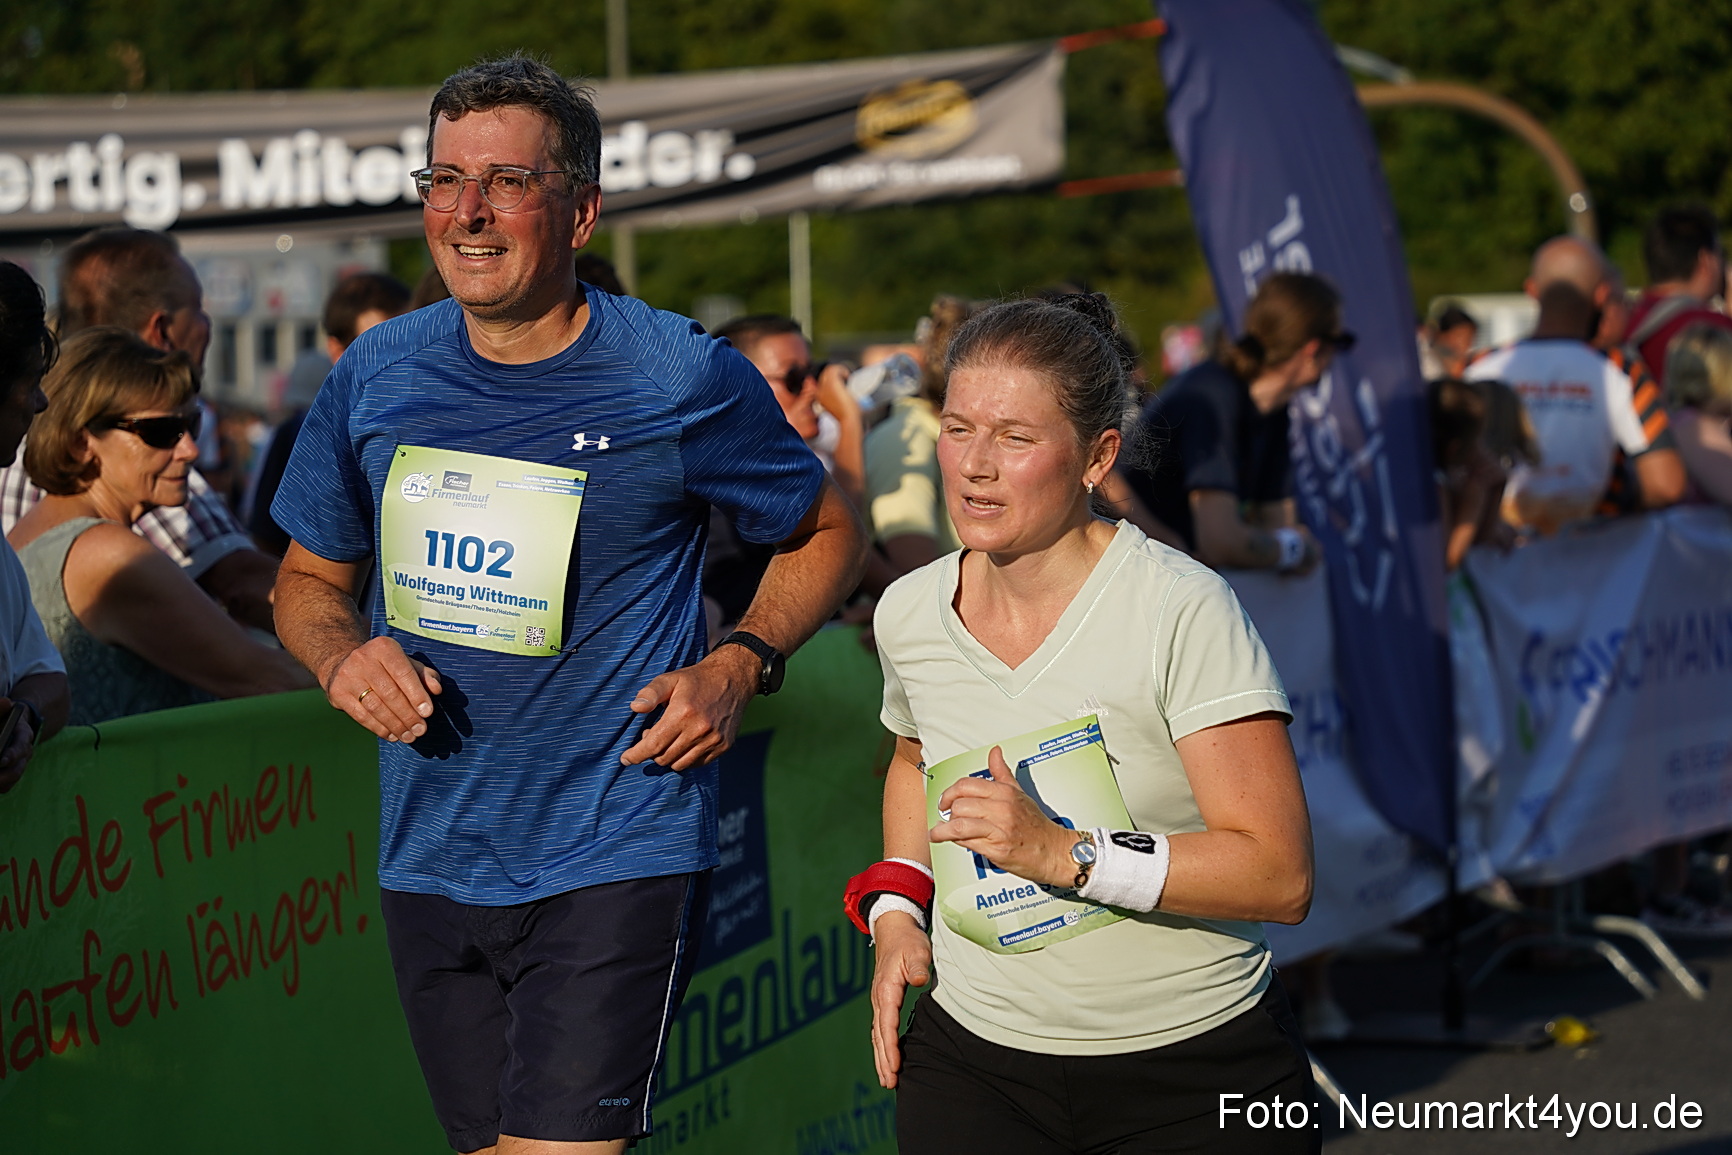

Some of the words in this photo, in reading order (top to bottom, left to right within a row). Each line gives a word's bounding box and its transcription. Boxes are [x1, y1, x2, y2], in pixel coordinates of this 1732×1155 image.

[431, 488, 490, 502] Firmenlauf
[452, 500, 487, 509] neumarkt
[425, 529, 515, 579] 1102
[394, 571, 465, 601] Wolfgang
[470, 585, 548, 611] Wittmann
[416, 595, 445, 605] Grundschule
[420, 619, 474, 634] firmenlauf.bayern
[489, 631, 516, 639] Firmenlauf
[143, 763, 317, 879] Firmen
[975, 884, 1037, 910] Andrea
[186, 831, 368, 998] länger!
[986, 907, 1020, 919] Grundschule
[1002, 920, 1062, 945] firmenlauf.bayern
